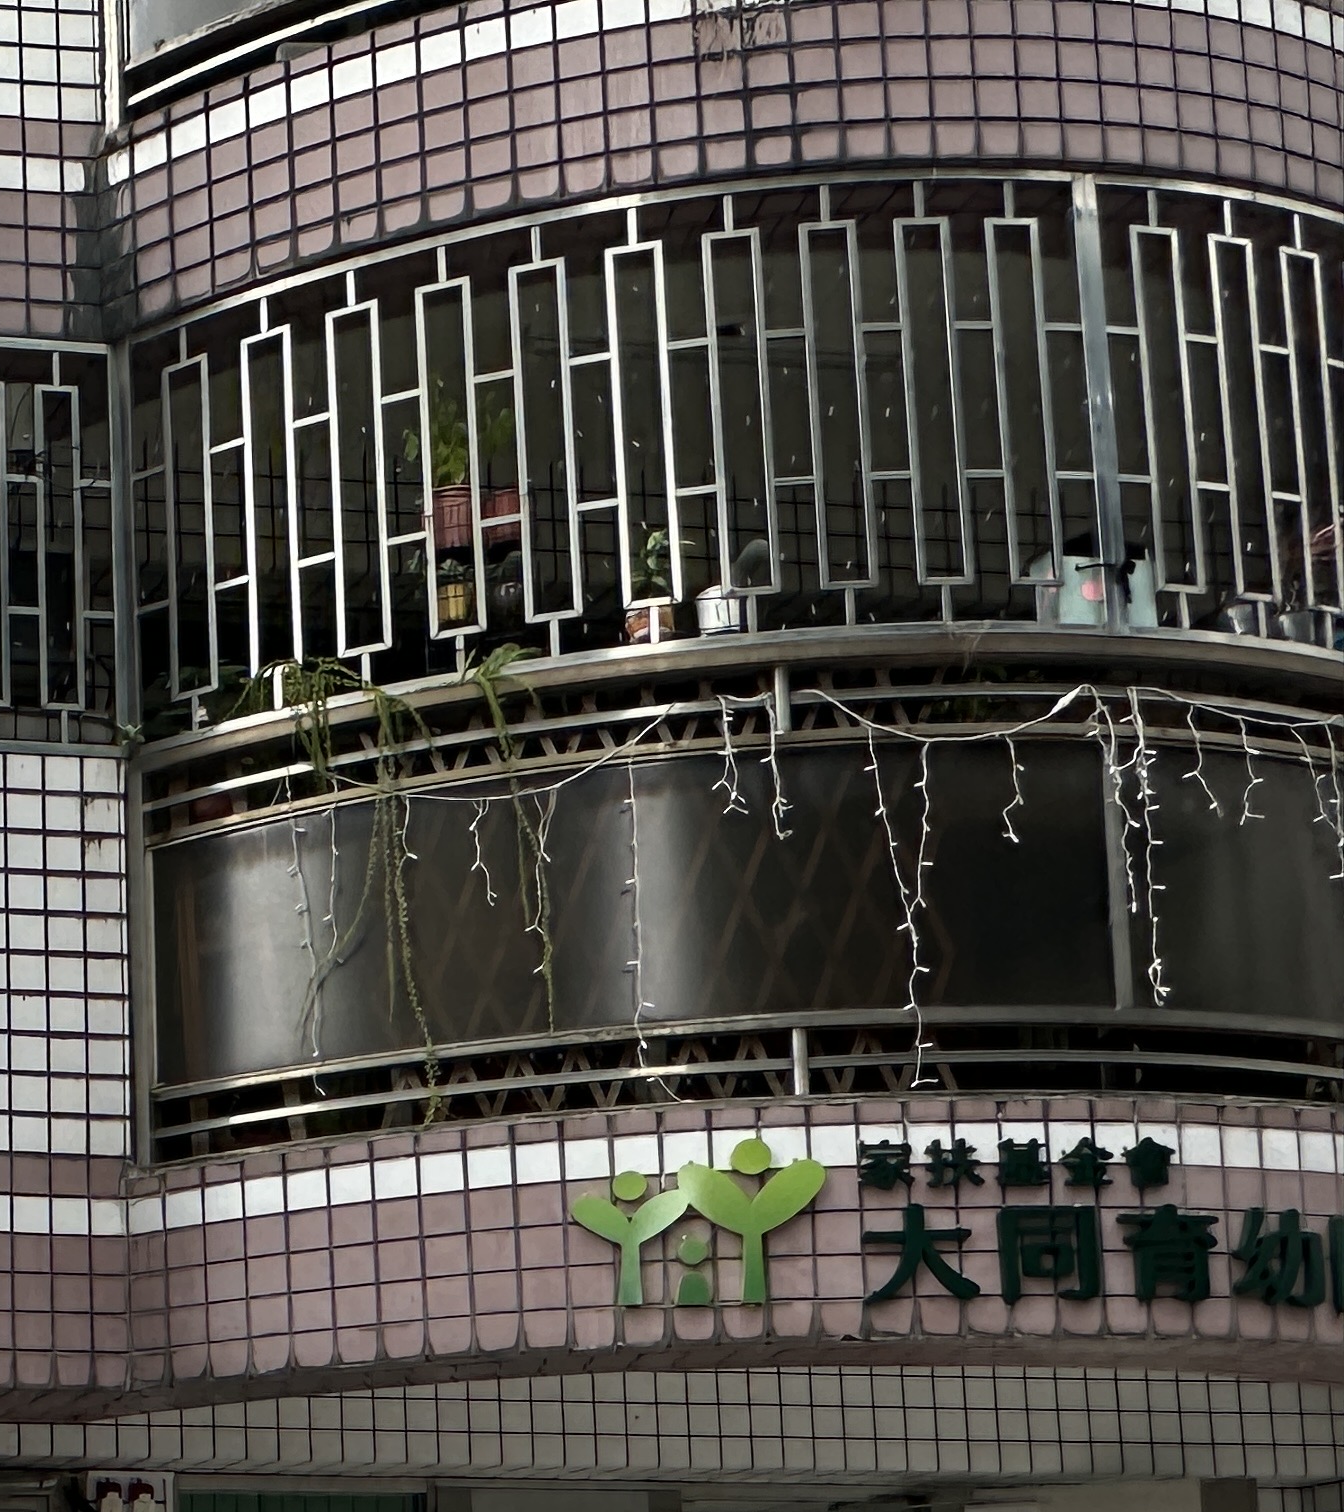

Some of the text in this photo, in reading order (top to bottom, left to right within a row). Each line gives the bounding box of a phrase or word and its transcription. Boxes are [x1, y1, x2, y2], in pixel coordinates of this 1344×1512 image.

[860, 1137, 1177, 1189] 家扶基金會
[863, 1203, 1344, 1314] 大同育幼
